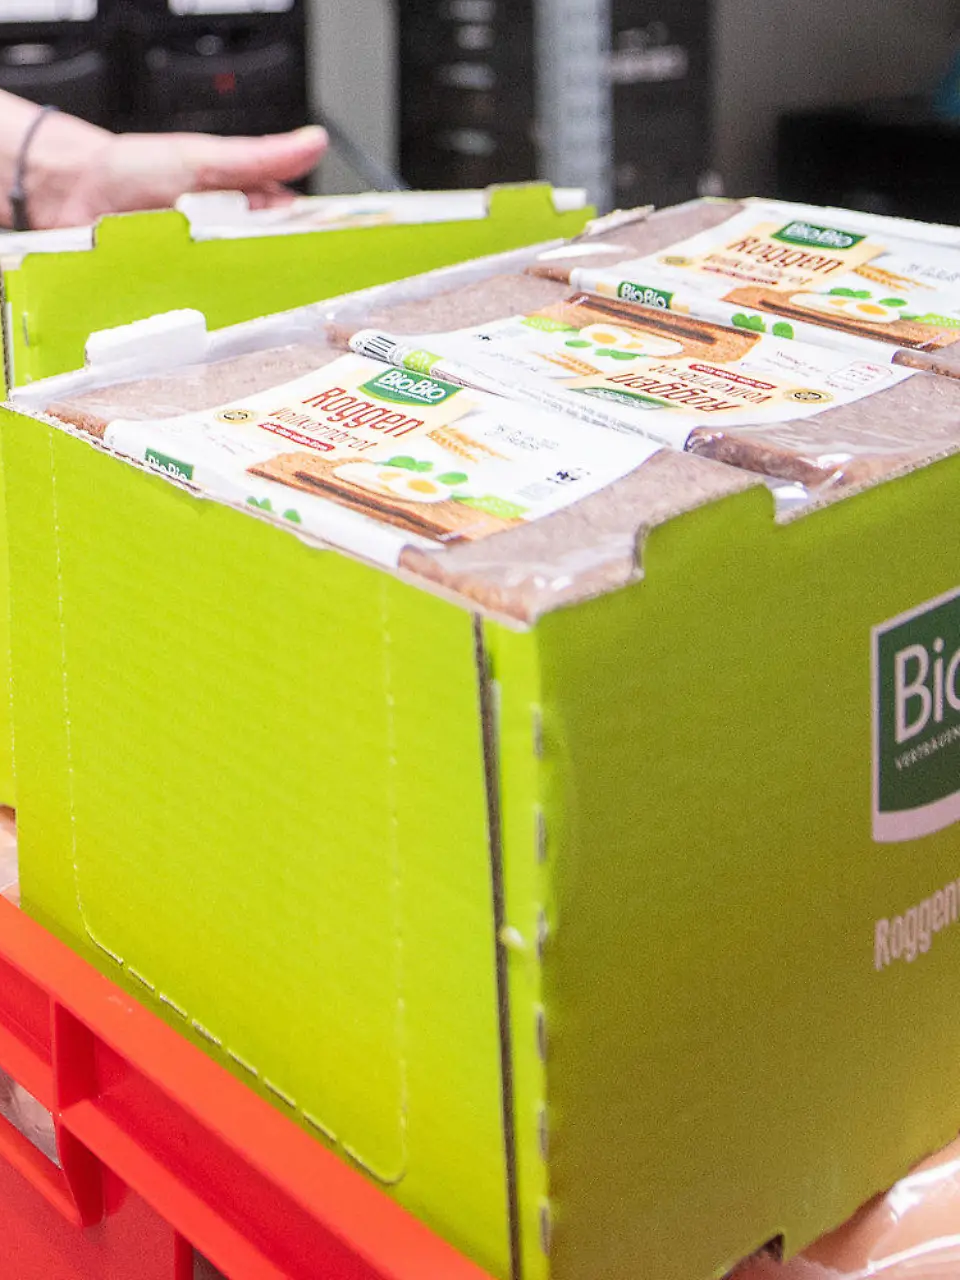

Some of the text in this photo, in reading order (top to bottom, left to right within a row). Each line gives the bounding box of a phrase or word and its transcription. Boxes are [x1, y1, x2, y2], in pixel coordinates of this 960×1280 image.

[726, 235, 844, 275] Roggen
[621, 283, 667, 309] BioBio
[377, 370, 446, 400] BioBio
[606, 373, 741, 413] Roggen
[301, 387, 425, 438] Roggen
[874, 877, 960, 970] Roggen
